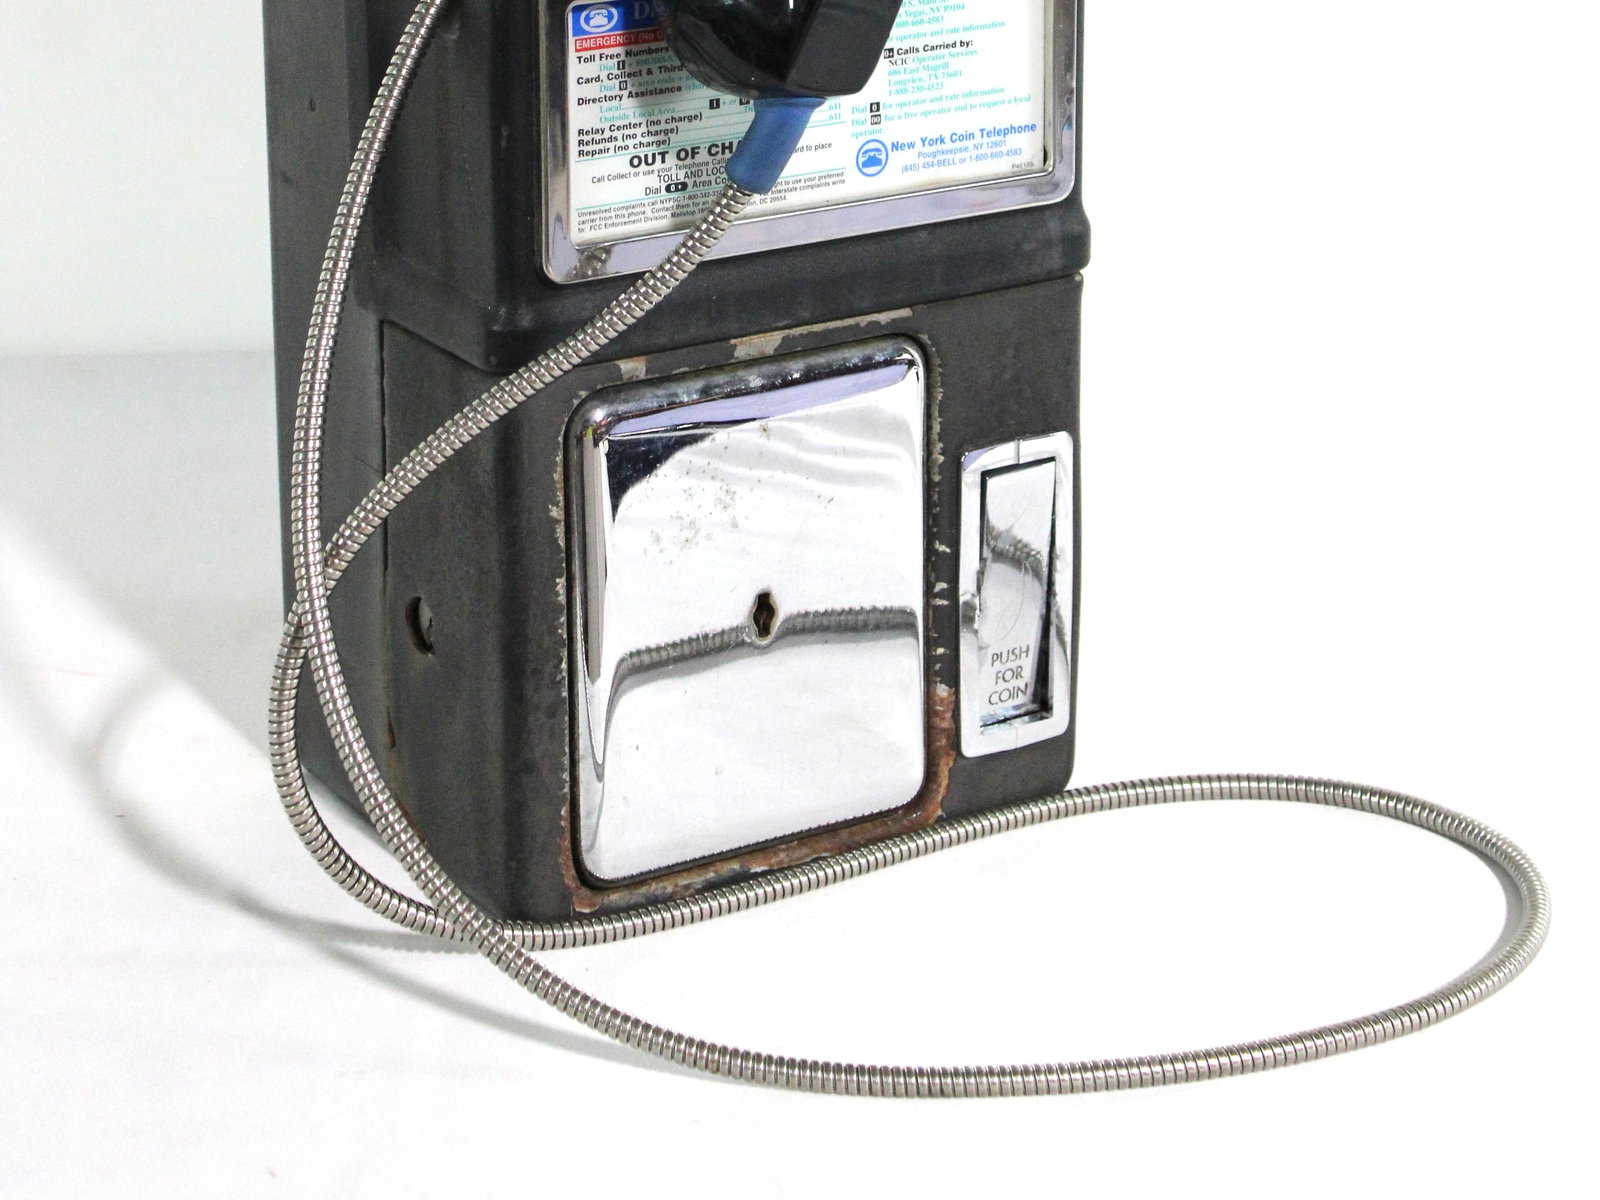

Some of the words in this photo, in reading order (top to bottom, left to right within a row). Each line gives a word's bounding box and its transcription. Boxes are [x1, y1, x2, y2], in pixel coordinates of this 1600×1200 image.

[962, 20, 1006, 34] information
[576, 34, 635, 50] EMERGENCY
[897, 46, 920, 56] Calls
[923, 42, 957, 52] Carried
[960, 39, 974, 49] by:
[577, 54, 596, 65] Toll
[600, 52, 621, 63] Free
[625, 46, 670, 59] Numbers
[888, 57, 911, 68] NCIC
[912, 54, 946, 66] Operator
[948, 49, 978, 59] Services
[576, 74, 604, 86] Card,
[608, 70, 642, 82] Collect
[658, 64, 684, 74] Third
[600, 63, 616, 72] Dial
[904, 67, 919, 76] East
[577, 92, 624, 106] Directory
[628, 85, 682, 99] Assistance
[600, 84, 616, 93] Dial
[600, 105, 622, 114] Local
[852, 106, 867, 114] Dial
[896, 98, 926, 110] operator
[929, 96, 944, 104] and
[945, 94, 960, 102] rate
[962, 86, 1005, 100] information
[600, 113, 630, 124] Outside
[633, 110, 655, 119] Local
[657, 106, 676, 116] Area
[852, 117, 867, 127] Dial
[920, 106, 952, 118] operator
[954, 104, 968, 112] and
[980, 100, 1006, 112] request
[1014, 95, 1032, 104] local
[578, 127, 606, 140] Relay
[610, 122, 644, 134] Center
[646, 118, 662, 130] (no
[664, 112, 703, 128] charge)
[578, 134, 618, 149] Refunds
[622, 132, 638, 144] (no
[640, 125, 679, 140] charge)
[890, 140, 916, 153] New
[920, 134, 946, 148] York
[950, 130, 975, 144] Coin
[979, 122, 1038, 140] Telephone
[578, 146, 610, 159] Repair
[614, 142, 630, 154] (no
[632, 136, 672, 152] charge)
[814, 142, 832, 153] place
[918, 146, 970, 161] Poughkeepsie,
[974, 142, 984, 152] NY
[628, 150, 670, 169] OUT
[676, 146, 702, 162] OF
[902, 162, 920, 174] (845)
[922, 157, 957, 171] 454-BELL
[592, 174, 605, 184] Call
[606, 170, 632, 183] Collect
[642, 168, 656, 176] use
[656, 166, 672, 178] your
[674, 160, 710, 173] Telephone
[658, 173, 681, 184] TOLL
[684, 169, 704, 182] AND
[792, 178, 802, 186] use
[804, 176, 817, 185] your
[818, 171, 844, 184] preferred
[645, 184, 662, 197] Dial
[692, 180, 712, 190] Area
[770, 186, 798, 196] Interstate
[799, 180, 830, 193] complaints
[832, 178, 846, 188] write
[578, 206, 612, 218] Unresolved
[613, 202, 646, 216] complaints
[648, 199, 658, 208] call
[660, 194, 682, 206] NYPSC
[760, 196, 768, 204] DC
[770, 194, 787, 204] 20554
[578, 216, 598, 227] carrier
[598, 212, 614, 223] from
[614, 210, 626, 221] this
[628, 208, 648, 221] phone.
[651, 204, 675, 216] Contact
[676, 202, 690, 212] them
[590, 222, 604, 232] FCC
[604, 216, 643, 231] Enforcement
[671, 208, 697, 222] Mailstop
[991, 644, 1030, 668] PUSH
[995, 665, 1024, 686] FOR
[988, 682, 1028, 706] COIN
